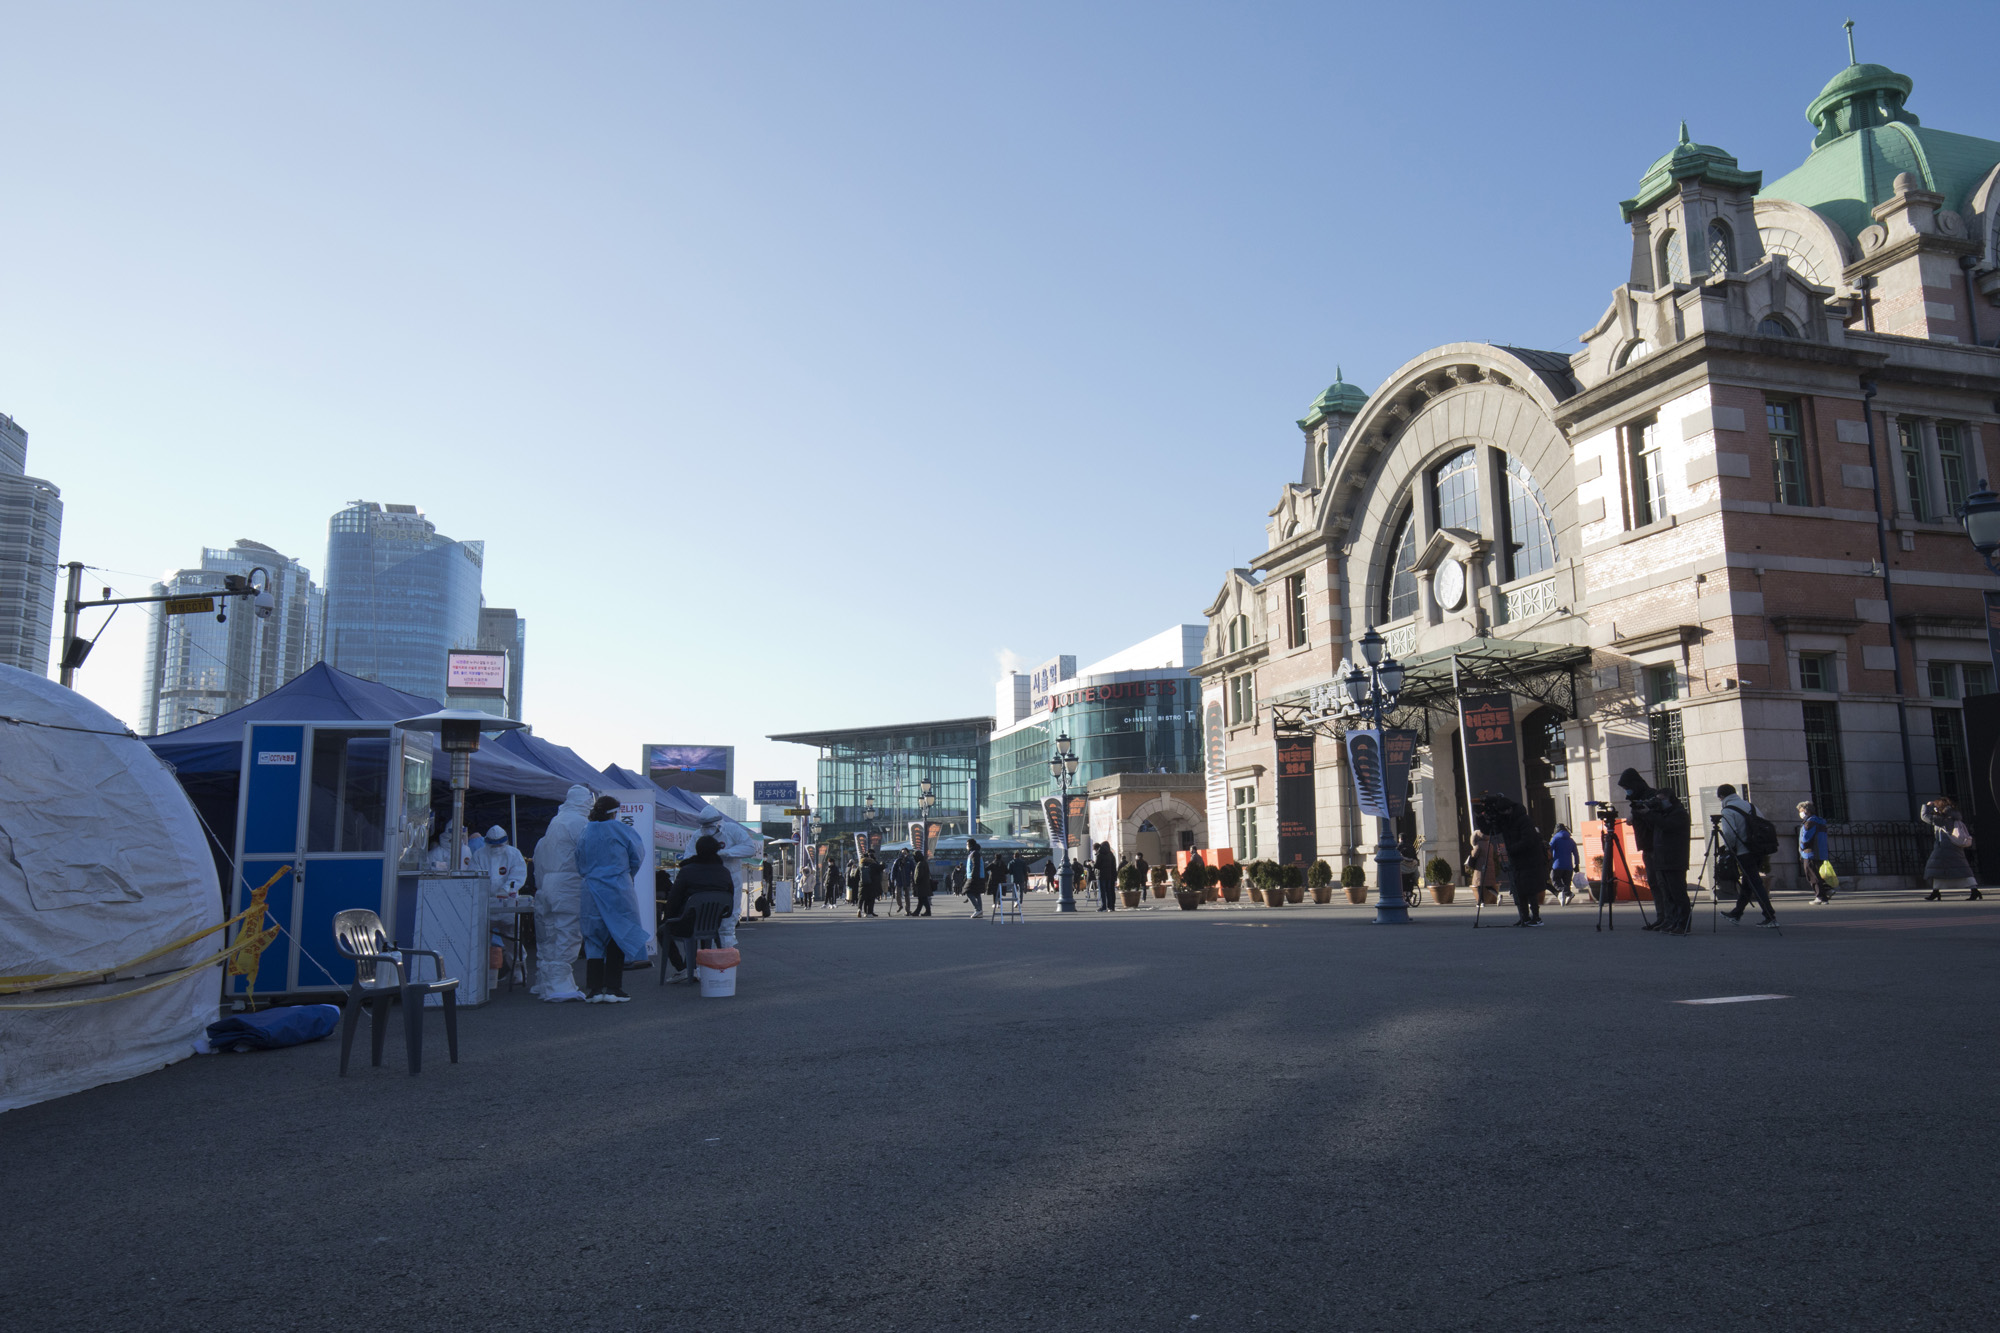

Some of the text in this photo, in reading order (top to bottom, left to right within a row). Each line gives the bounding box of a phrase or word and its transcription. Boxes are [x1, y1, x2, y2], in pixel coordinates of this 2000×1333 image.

[1033, 664, 1057, 693] 서울역
[1054, 687, 1095, 708] LOTTE
[1100, 680, 1177, 700] OUTLETS
[765, 789, 787, 798] 주차장
[619, 804, 644, 813] 로나19
